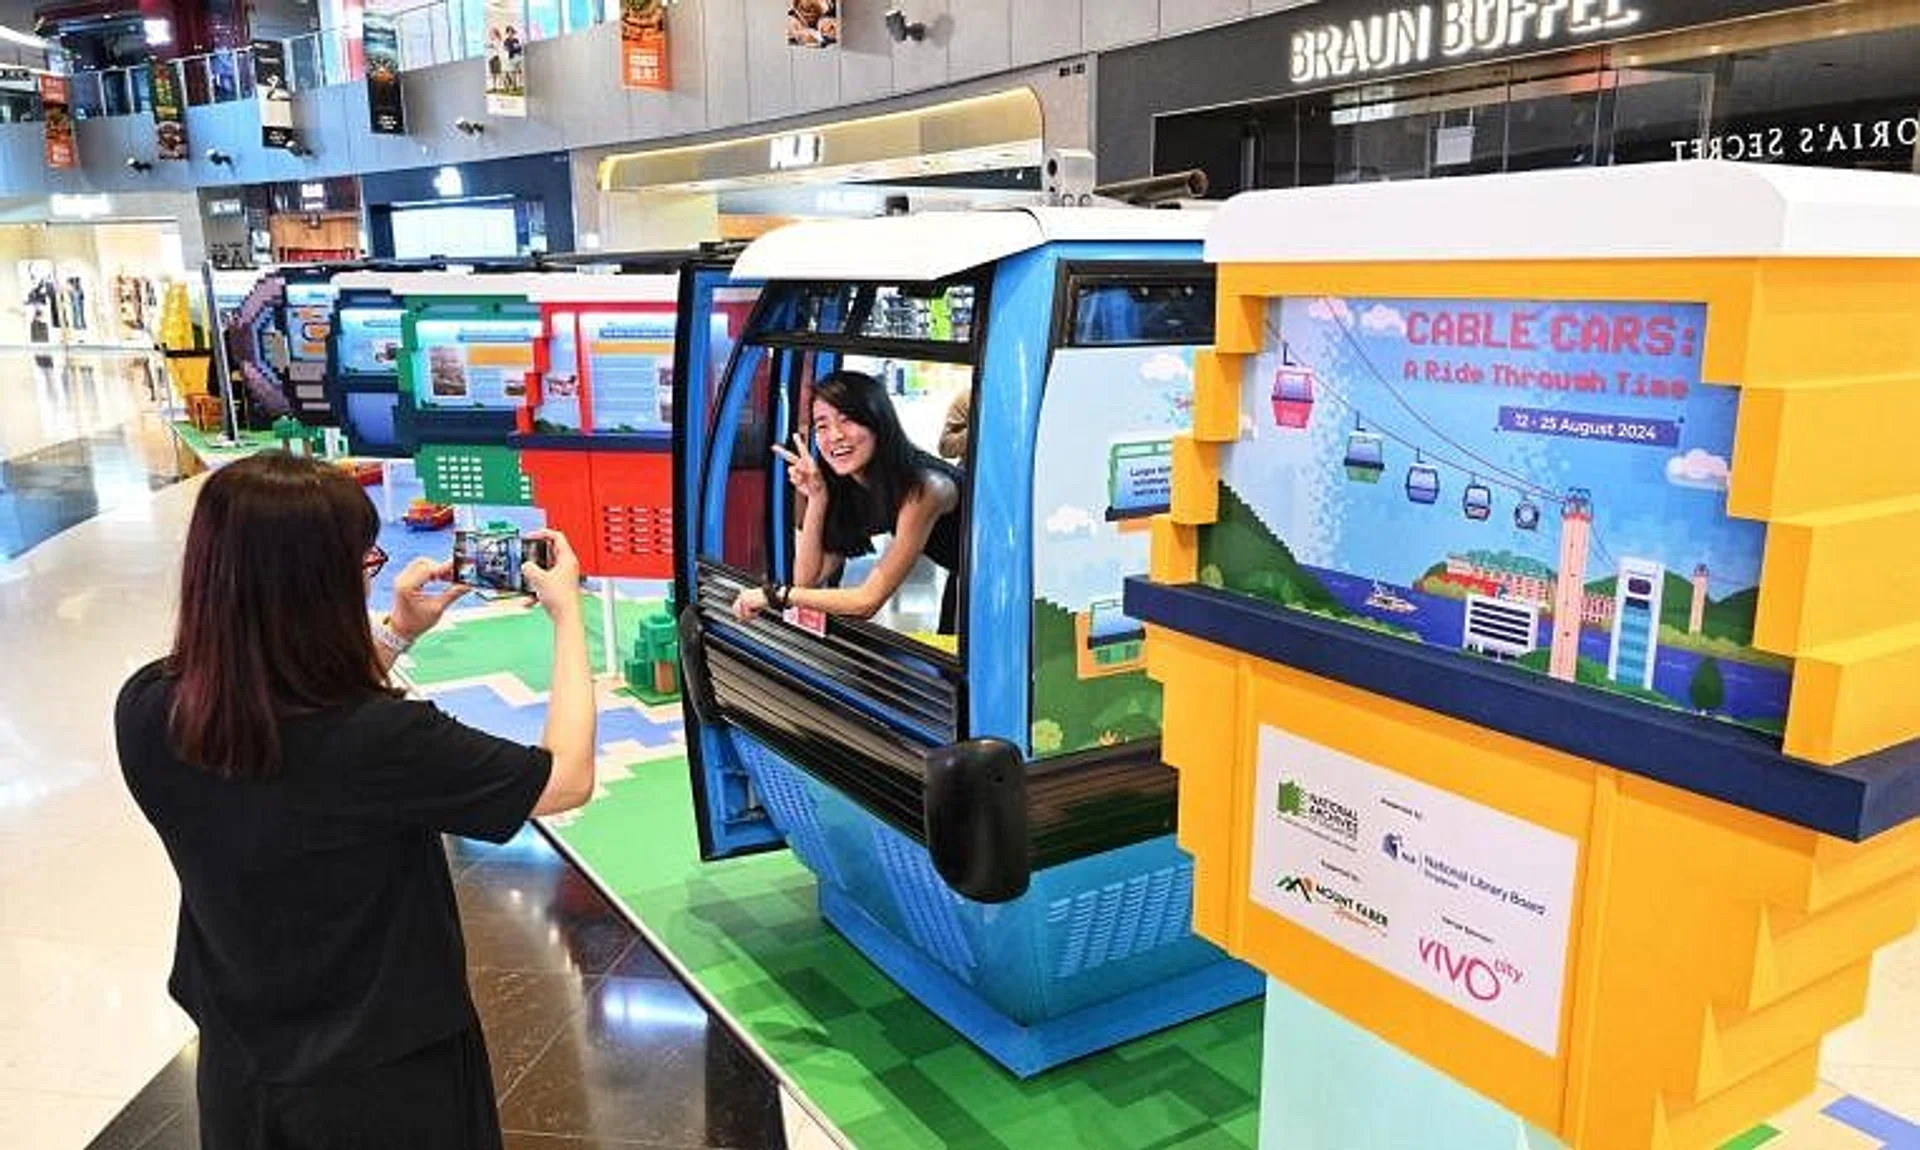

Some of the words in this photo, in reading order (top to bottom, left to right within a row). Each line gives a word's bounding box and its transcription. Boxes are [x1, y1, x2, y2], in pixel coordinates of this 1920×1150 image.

[1291, 4, 1432, 83] BRAUN
[1407, 311, 1536, 350] CABLE
[1550, 315, 1696, 357] CARS:
[1404, 360, 1418, 381] A
[1425, 360, 1484, 384] Ride
[1492, 363, 1607, 394] Through
[1616, 370, 1690, 400] Time
[1513, 412, 1529, 427] 12
[1539, 415, 1557, 430] 25
[1559, 417, 1615, 437] August
[1617, 421, 1656, 440] 2024
[1316, 883, 1354, 909] MOUNT
[1355, 901, 1388, 927] FABER
[1424, 853, 1468, 883] National
[1470, 874, 1508, 902] Library
[1509, 890, 1547, 915] Board
